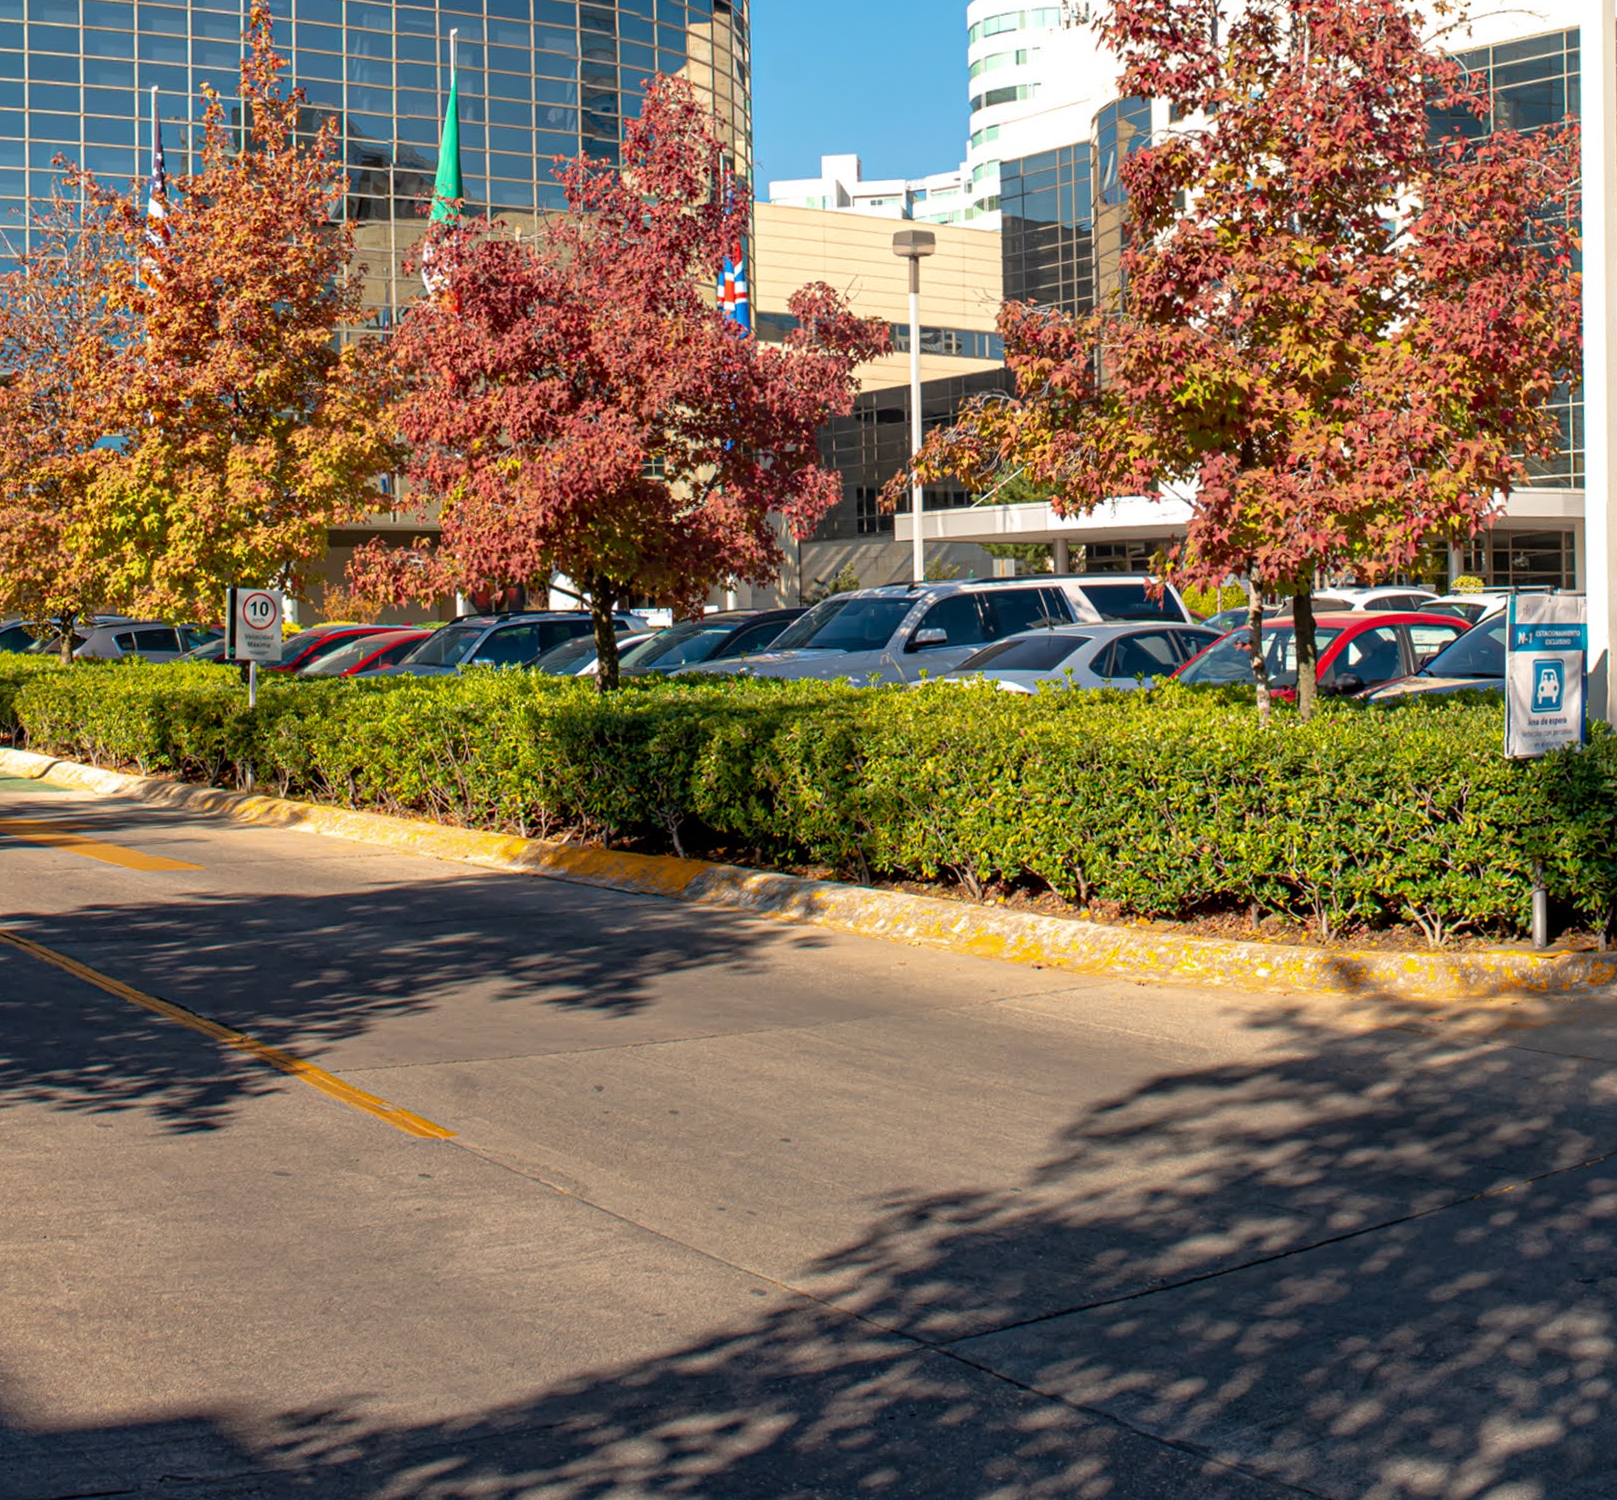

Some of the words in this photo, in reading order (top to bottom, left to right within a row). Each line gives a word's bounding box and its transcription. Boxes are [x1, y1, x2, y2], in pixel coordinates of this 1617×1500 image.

[251, 601, 269, 617] 10
[1518, 632, 1533, 645] N-1
[1535, 630, 1581, 638] ESTACIONAMIENTO
